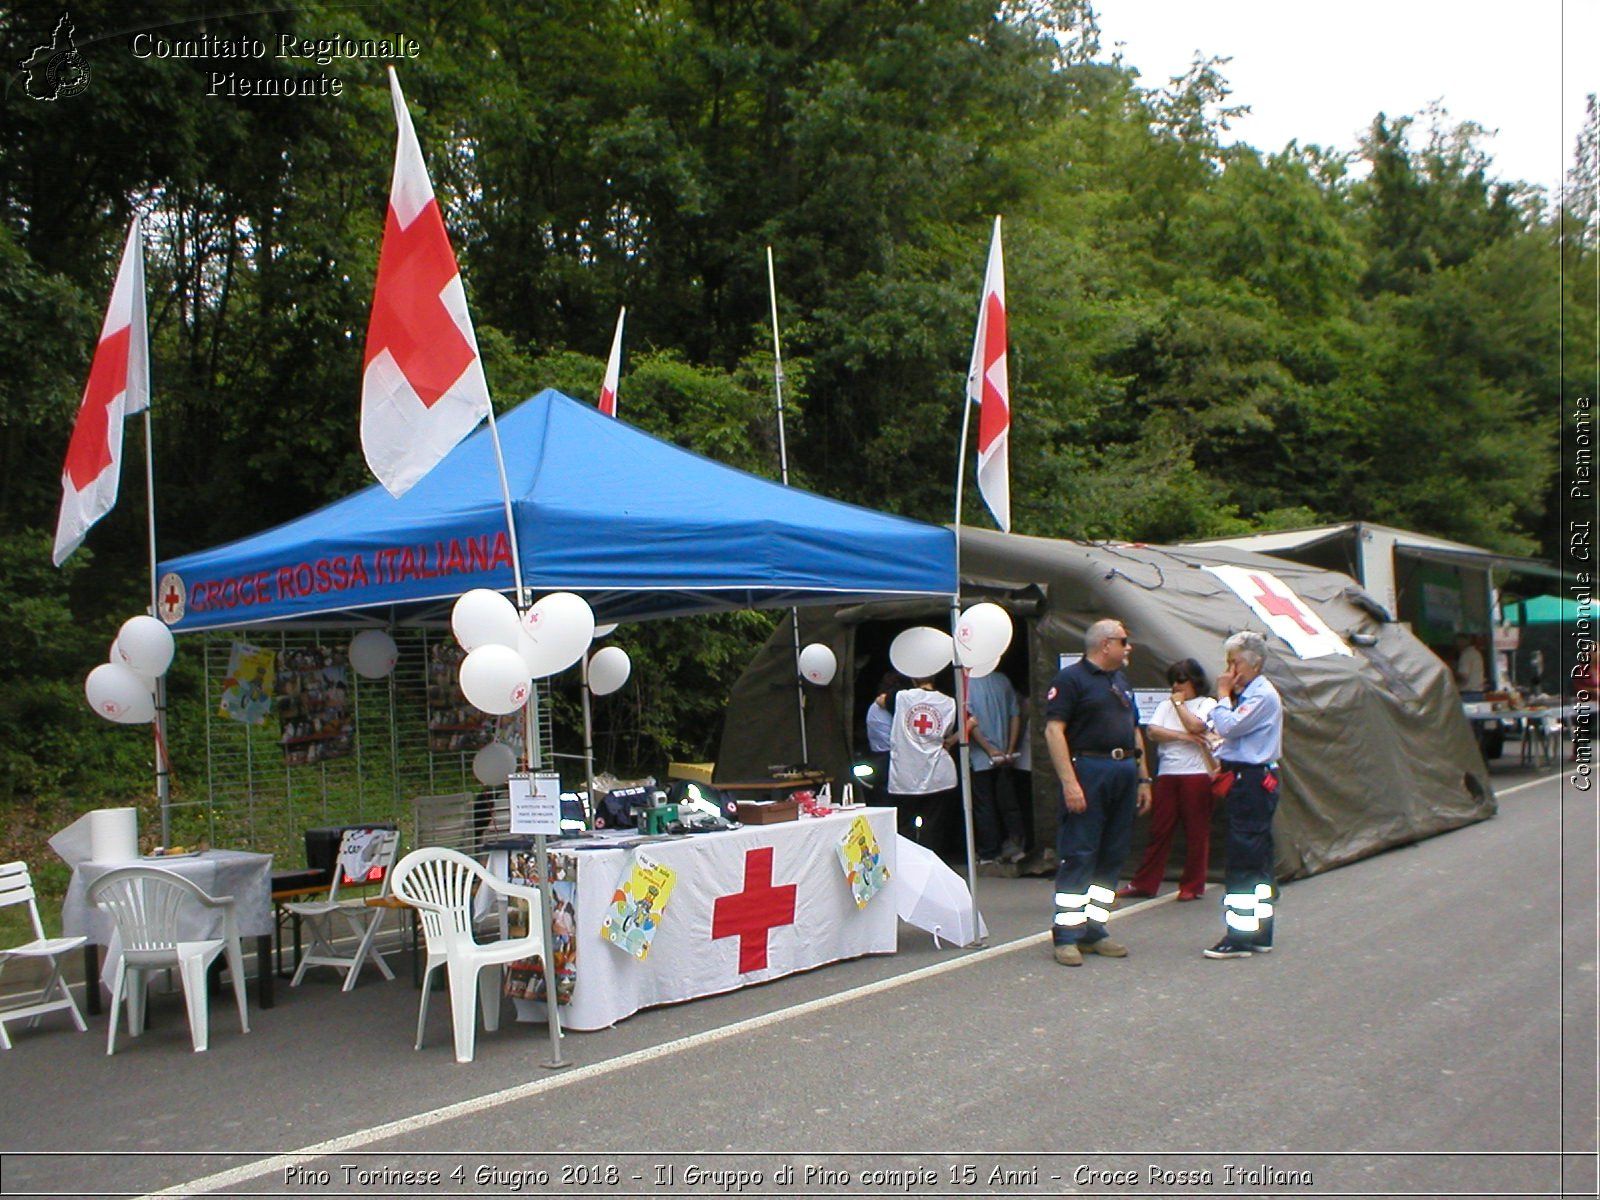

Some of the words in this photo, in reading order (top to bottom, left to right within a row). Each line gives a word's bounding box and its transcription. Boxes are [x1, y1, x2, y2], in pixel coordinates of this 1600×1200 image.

[189, 571, 273, 612] CROCE
[277, 554, 369, 601] ROSSA
[375, 531, 515, 586] ITALIANA
